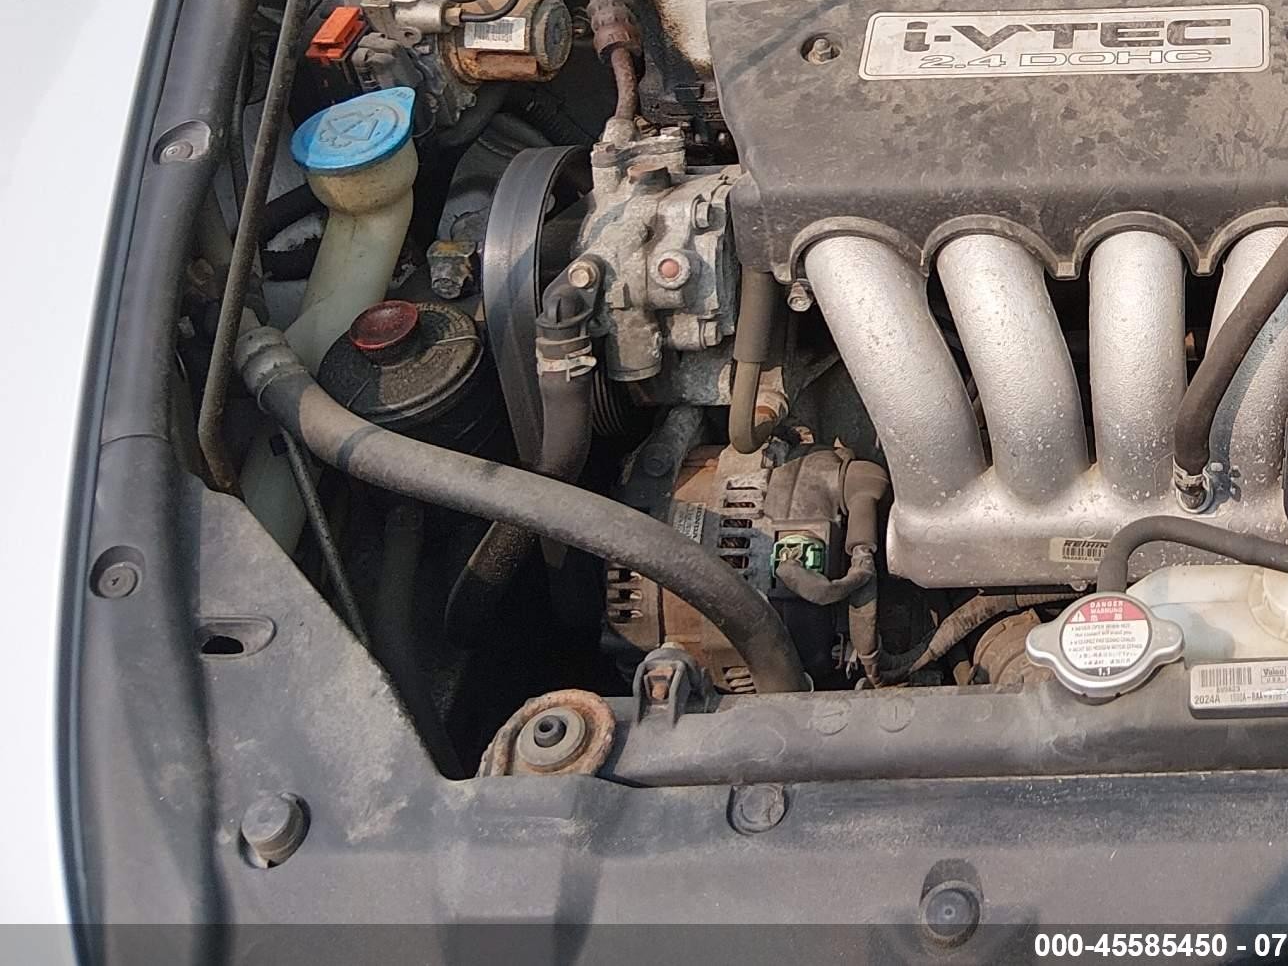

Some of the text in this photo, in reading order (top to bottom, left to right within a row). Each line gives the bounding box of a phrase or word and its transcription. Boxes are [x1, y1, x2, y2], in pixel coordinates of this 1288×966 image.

[904, 18, 1232, 53] i-VTEC
[919, 48, 1213, 69] 2.4 DOHC
[1090, 600, 1124, 608] DANGER
[1194, 694, 1221, 705] 2024A
